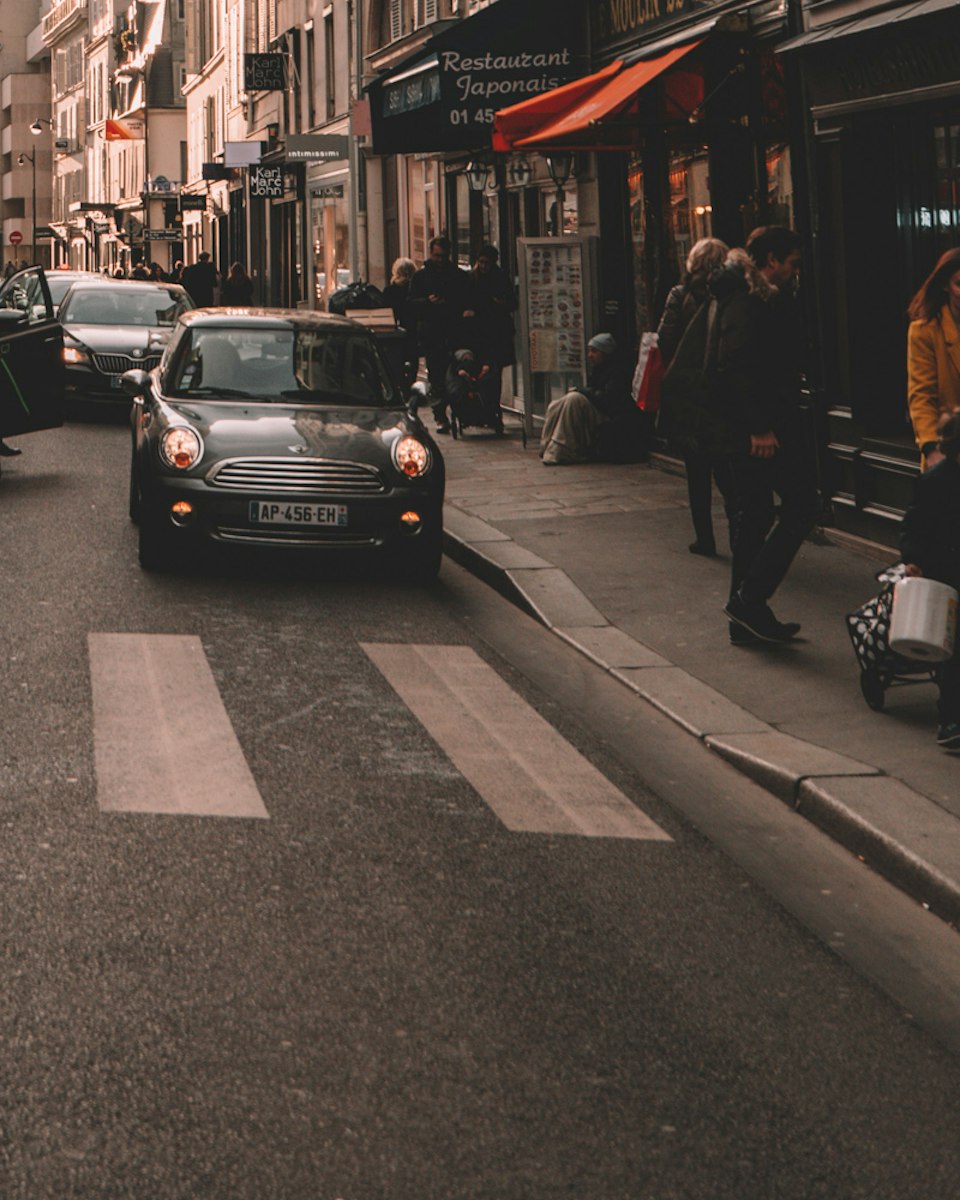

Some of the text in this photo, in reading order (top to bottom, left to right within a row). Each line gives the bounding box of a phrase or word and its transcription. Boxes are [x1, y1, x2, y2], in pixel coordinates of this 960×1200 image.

[252, 57, 280, 68] Karl
[441, 47, 571, 72] Restaurant
[246, 66, 281, 78] Marc
[247, 77, 281, 88] John
[456, 73, 559, 101] Japonais
[450, 108, 494, 125] 01 45
[288, 150, 340, 158] intimissimi
[256, 167, 281, 178] Karl
[251, 175, 281, 187] Marc
[251, 185, 282, 196] John
